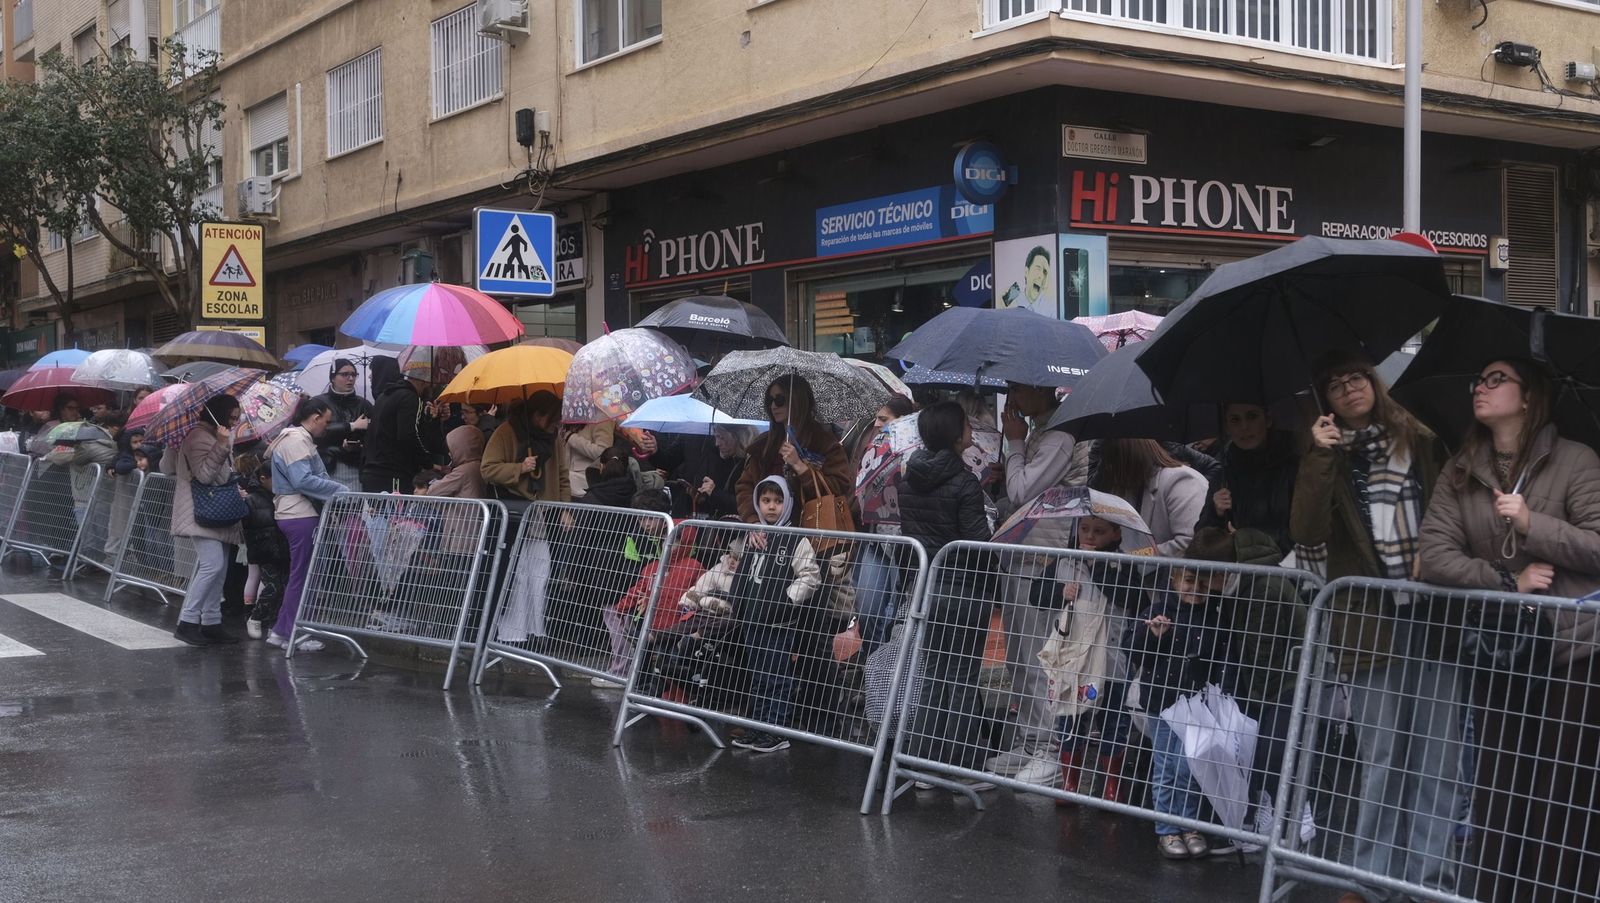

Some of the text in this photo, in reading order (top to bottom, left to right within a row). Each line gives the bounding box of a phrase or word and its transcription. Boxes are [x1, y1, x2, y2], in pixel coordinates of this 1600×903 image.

[1093, 132, 1117, 141] CALLE
[1067, 141, 1089, 153] DOCTOR
[965, 168, 1006, 181] DIGI
[1071, 170, 1295, 234] Hi PHONE
[821, 199, 933, 235] SERVICIO TÉCNICO
[951, 203, 988, 219] DIGI
[204, 227, 261, 240] ATENCIÓN
[821, 221, 933, 248] Reparación de todas las marcas de móviles
[625, 222, 765, 282] Hi PHONE
[217, 290, 248, 302] ZONA
[206, 303, 259, 314] ESCOLAR
[689, 313, 730, 325] Barceló
